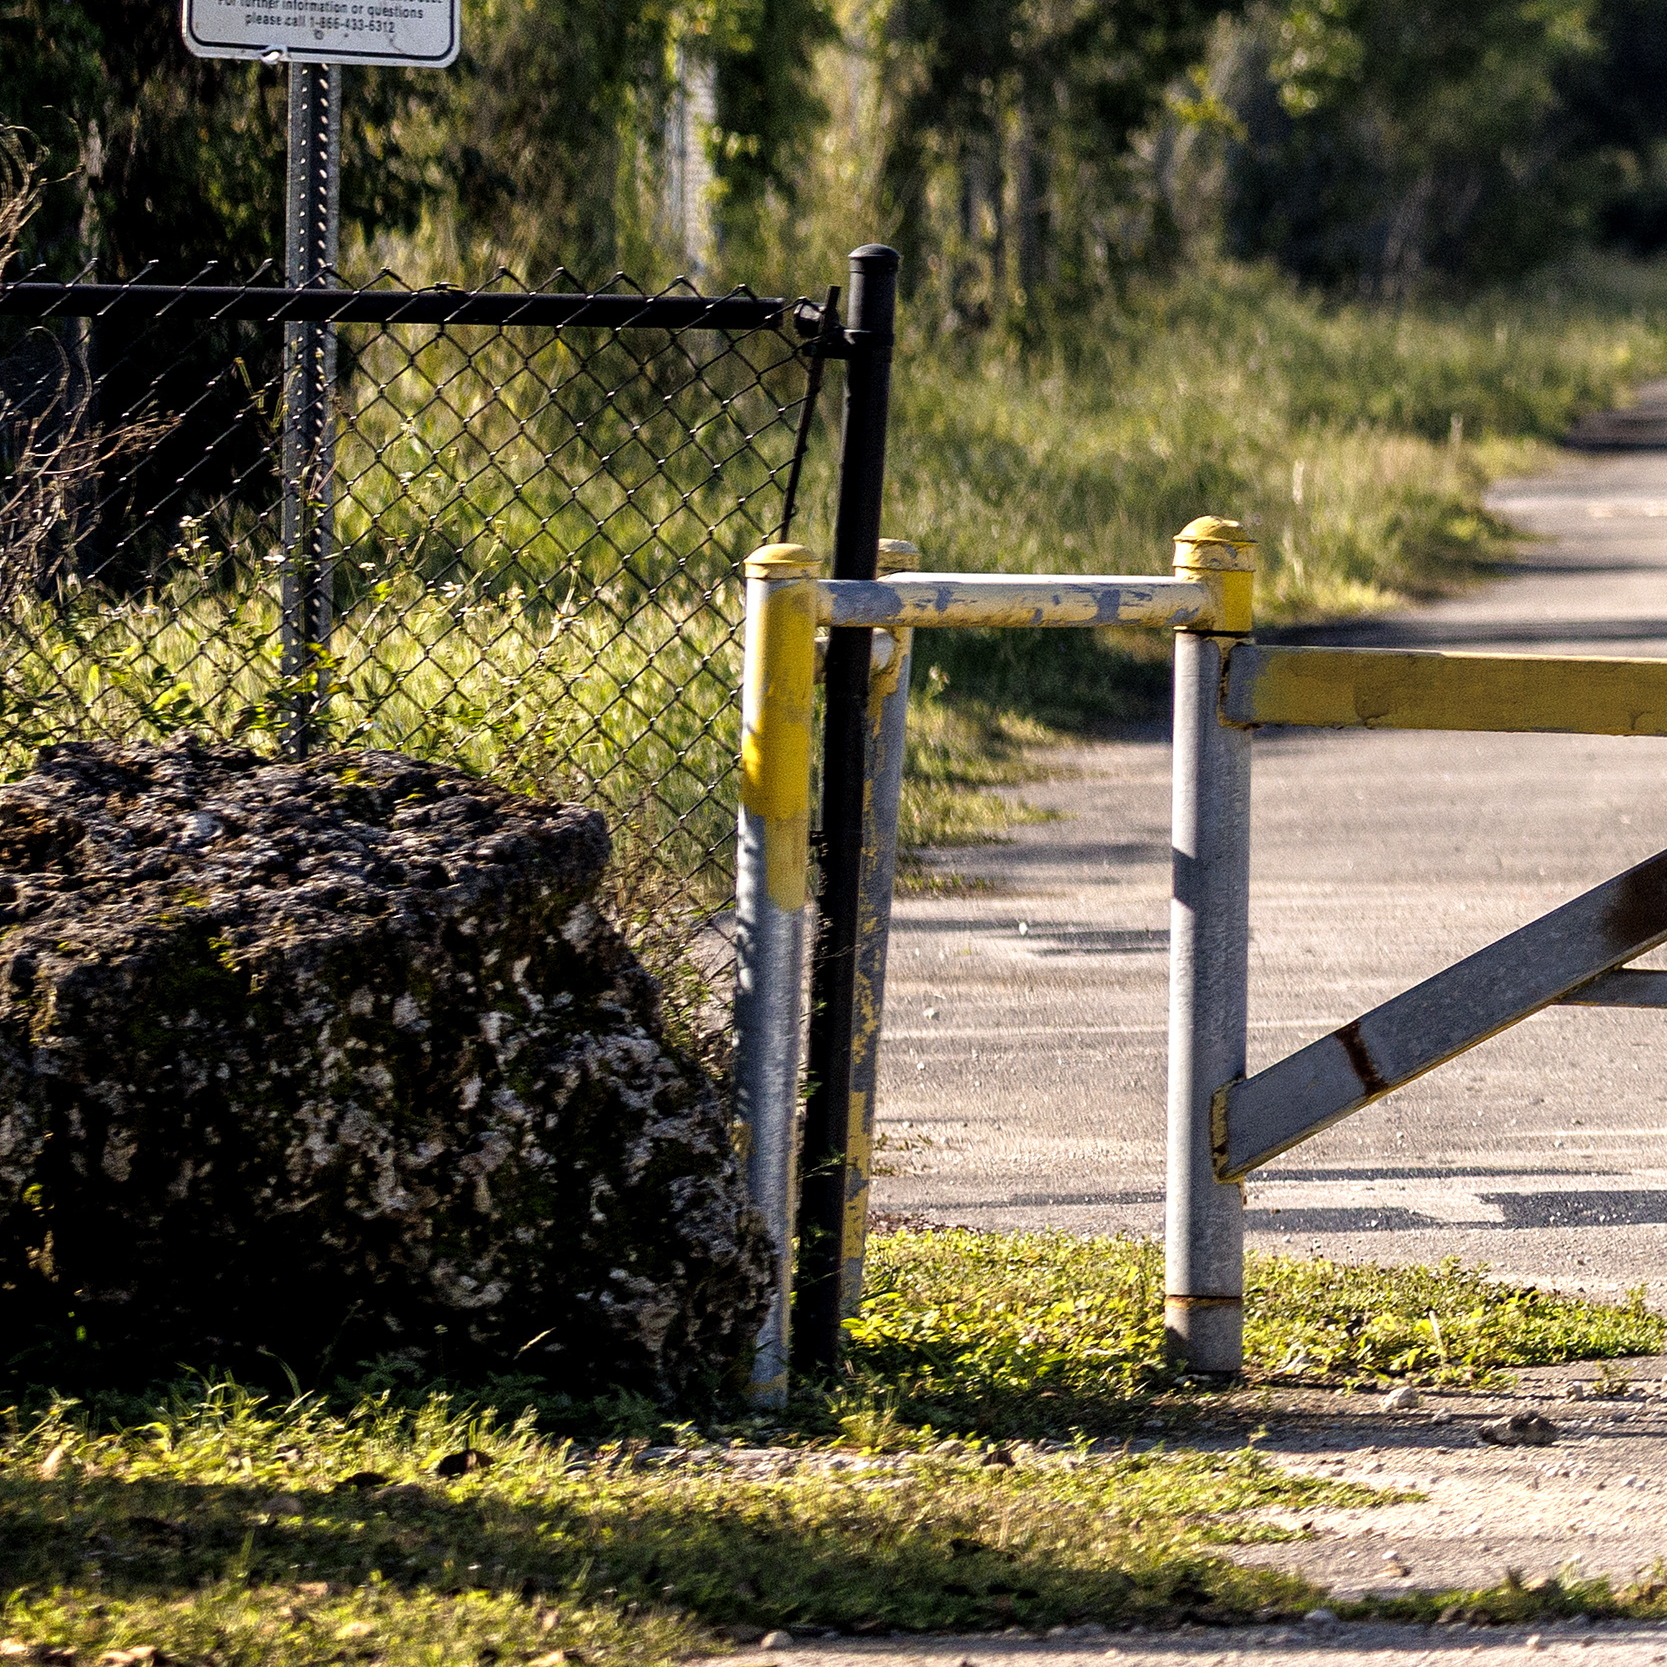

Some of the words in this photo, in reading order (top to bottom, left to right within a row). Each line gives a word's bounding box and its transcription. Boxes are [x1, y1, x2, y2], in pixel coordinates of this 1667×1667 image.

[351, 4, 364, 15] or
[367, 5, 424, 20] questions
[245, 12, 282, 27] please
[284, 14, 306, 27] call
[309, 15, 396, 34] 1-866-433-6312
